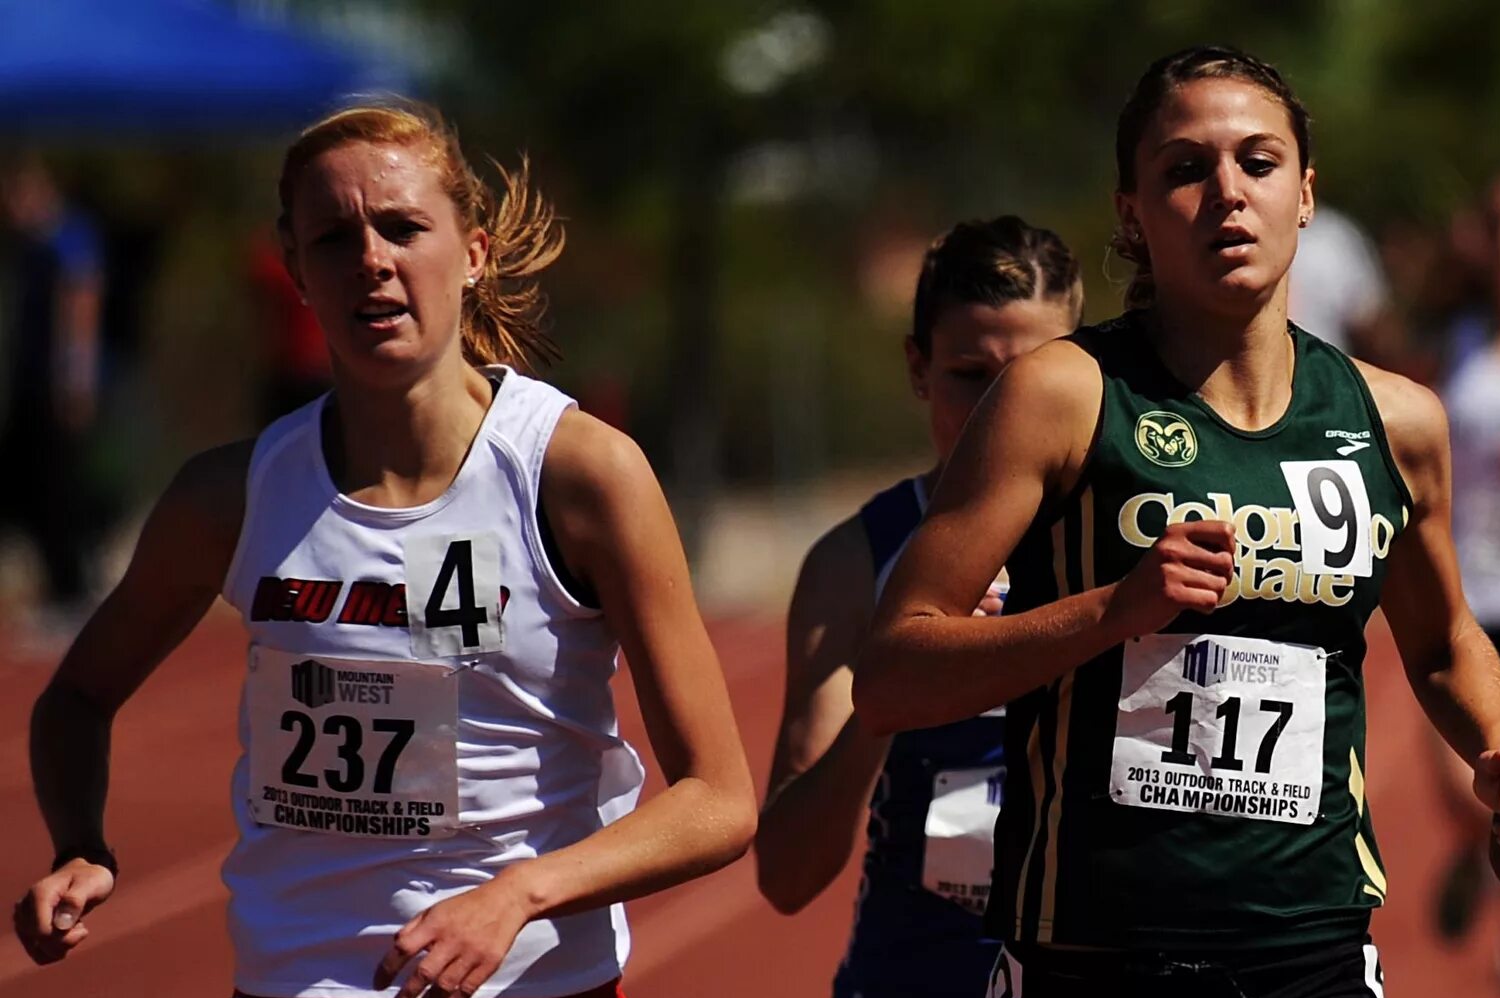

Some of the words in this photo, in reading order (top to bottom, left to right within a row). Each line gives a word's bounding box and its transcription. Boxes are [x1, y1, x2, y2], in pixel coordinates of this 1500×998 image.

[1325, 430, 1371, 440] BROOKS
[1118, 492, 1394, 559] Coloro
[1307, 467, 1358, 569] 9
[1214, 543, 1354, 606] tate
[251, 576, 343, 624] NEW
[425, 540, 488, 648] 4
[1232, 651, 1280, 665] MOUNTAIN
[1232, 665, 1279, 684] WEST
[337, 670, 394, 684] MOUNTAIN
[339, 685, 394, 704] WEST
[1161, 691, 1294, 774] 117
[280, 710, 415, 794] 237
[1128, 767, 1160, 783] 2013
[1164, 771, 1223, 791] OUTDOOR
[1229, 778, 1267, 795] TRACK
[1271, 783, 1279, 795] &
[1283, 784, 1311, 799] FIELD
[263, 786, 289, 804] 2013
[291, 792, 342, 812] OUTDOOR
[346, 799, 389, 815] TRACK
[393, 801, 404, 815] &
[407, 801, 445, 817] FIELD
[1140, 784, 1299, 818] CHAMPIONSHIPS
[274, 806, 430, 836] CHAMPIONSHIPS
